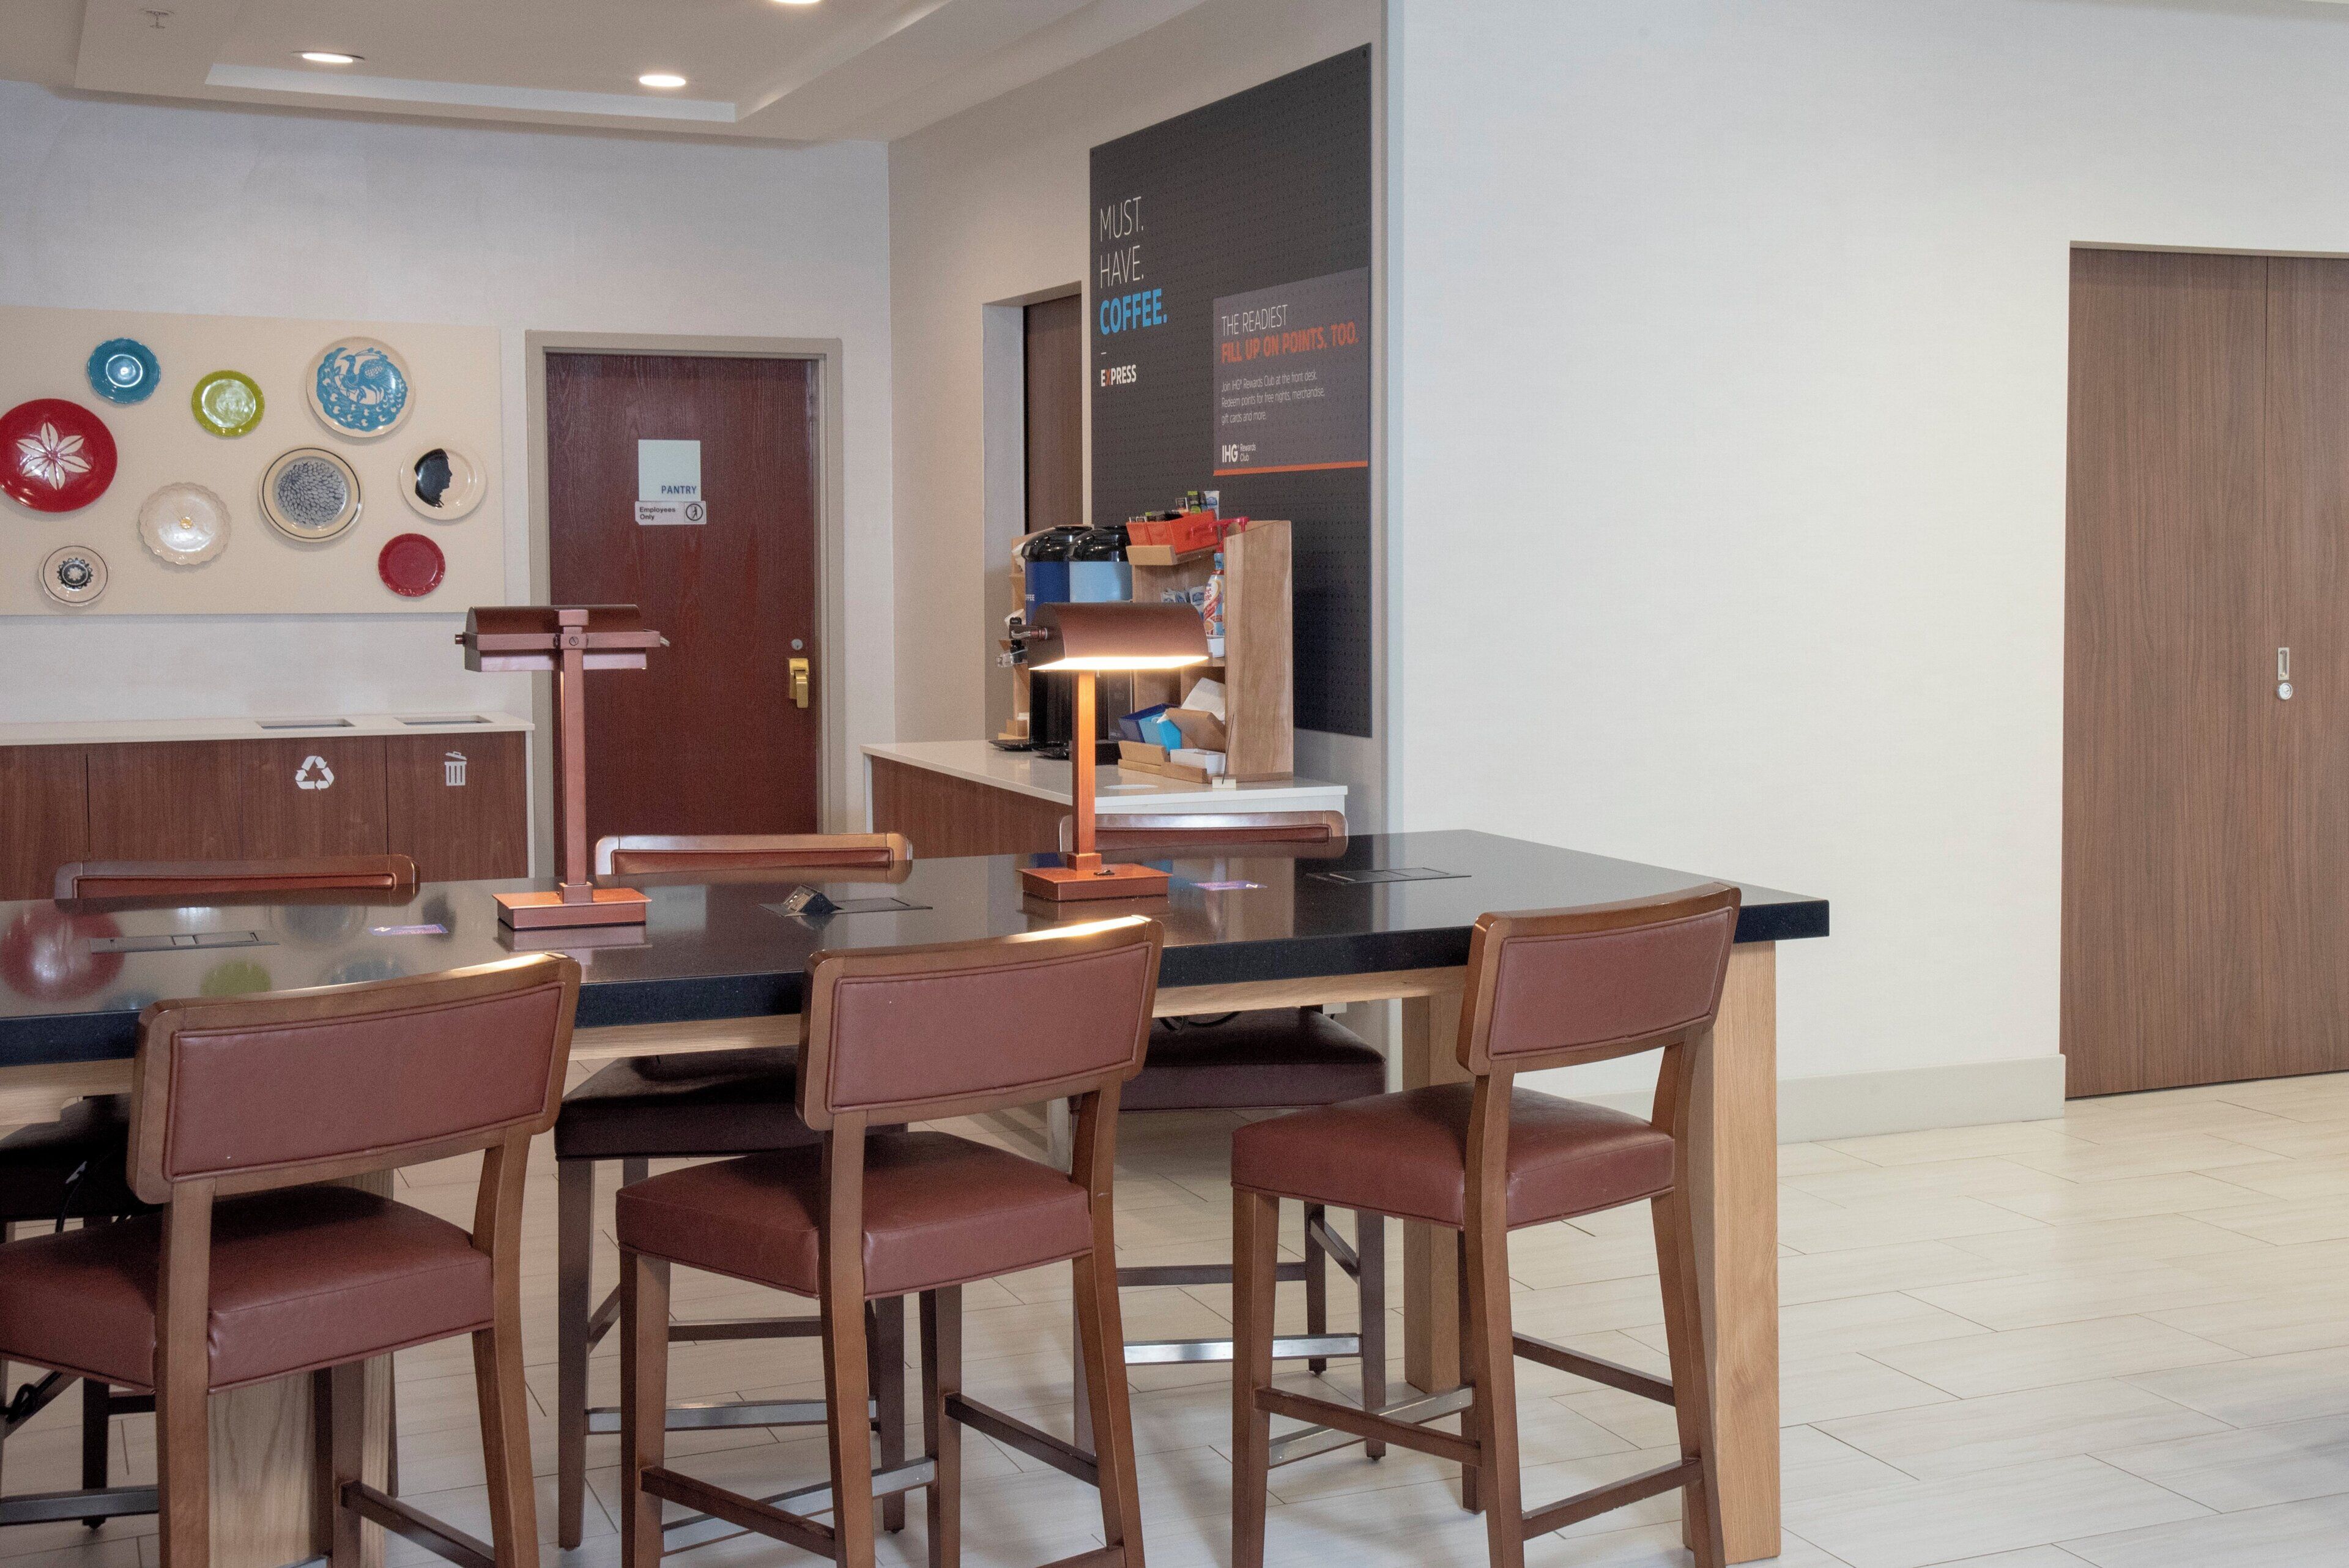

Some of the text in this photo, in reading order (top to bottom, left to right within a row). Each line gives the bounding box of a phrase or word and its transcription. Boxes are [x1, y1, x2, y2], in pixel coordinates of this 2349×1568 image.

[1100, 196, 1143, 242] MUST.
[1100, 245, 1143, 288] HAVE.
[1100, 288, 1167, 335] COFFEE.
[1222, 305, 1288, 336] THE READIEST
[1222, 341, 1242, 363] FILL
[1245, 337, 1260, 360] UP
[1263, 334, 1279, 357] ON
[1330, 321, 1359, 347] TOO.
[1100, 364, 1137, 387] EXPRESS
[1222, 381, 1231, 392] Join
[1243, 377, 1263, 389] Rewards
[1264, 374, 1275, 387] Club
[1275, 374, 1281, 385] at
[1291, 371, 1304, 384] front
[1222, 396, 1241, 407] Redeem
[1241, 395, 1256, 407] points
[1264, 392, 1274, 403] free
[1230, 412, 1242, 423] cards
[1243, 411, 1253, 422] and
[1240, 442, 1256, 451] Rewards
[1240, 452, 1250, 462] Club
[661, 485, 697, 494] PANTRY
